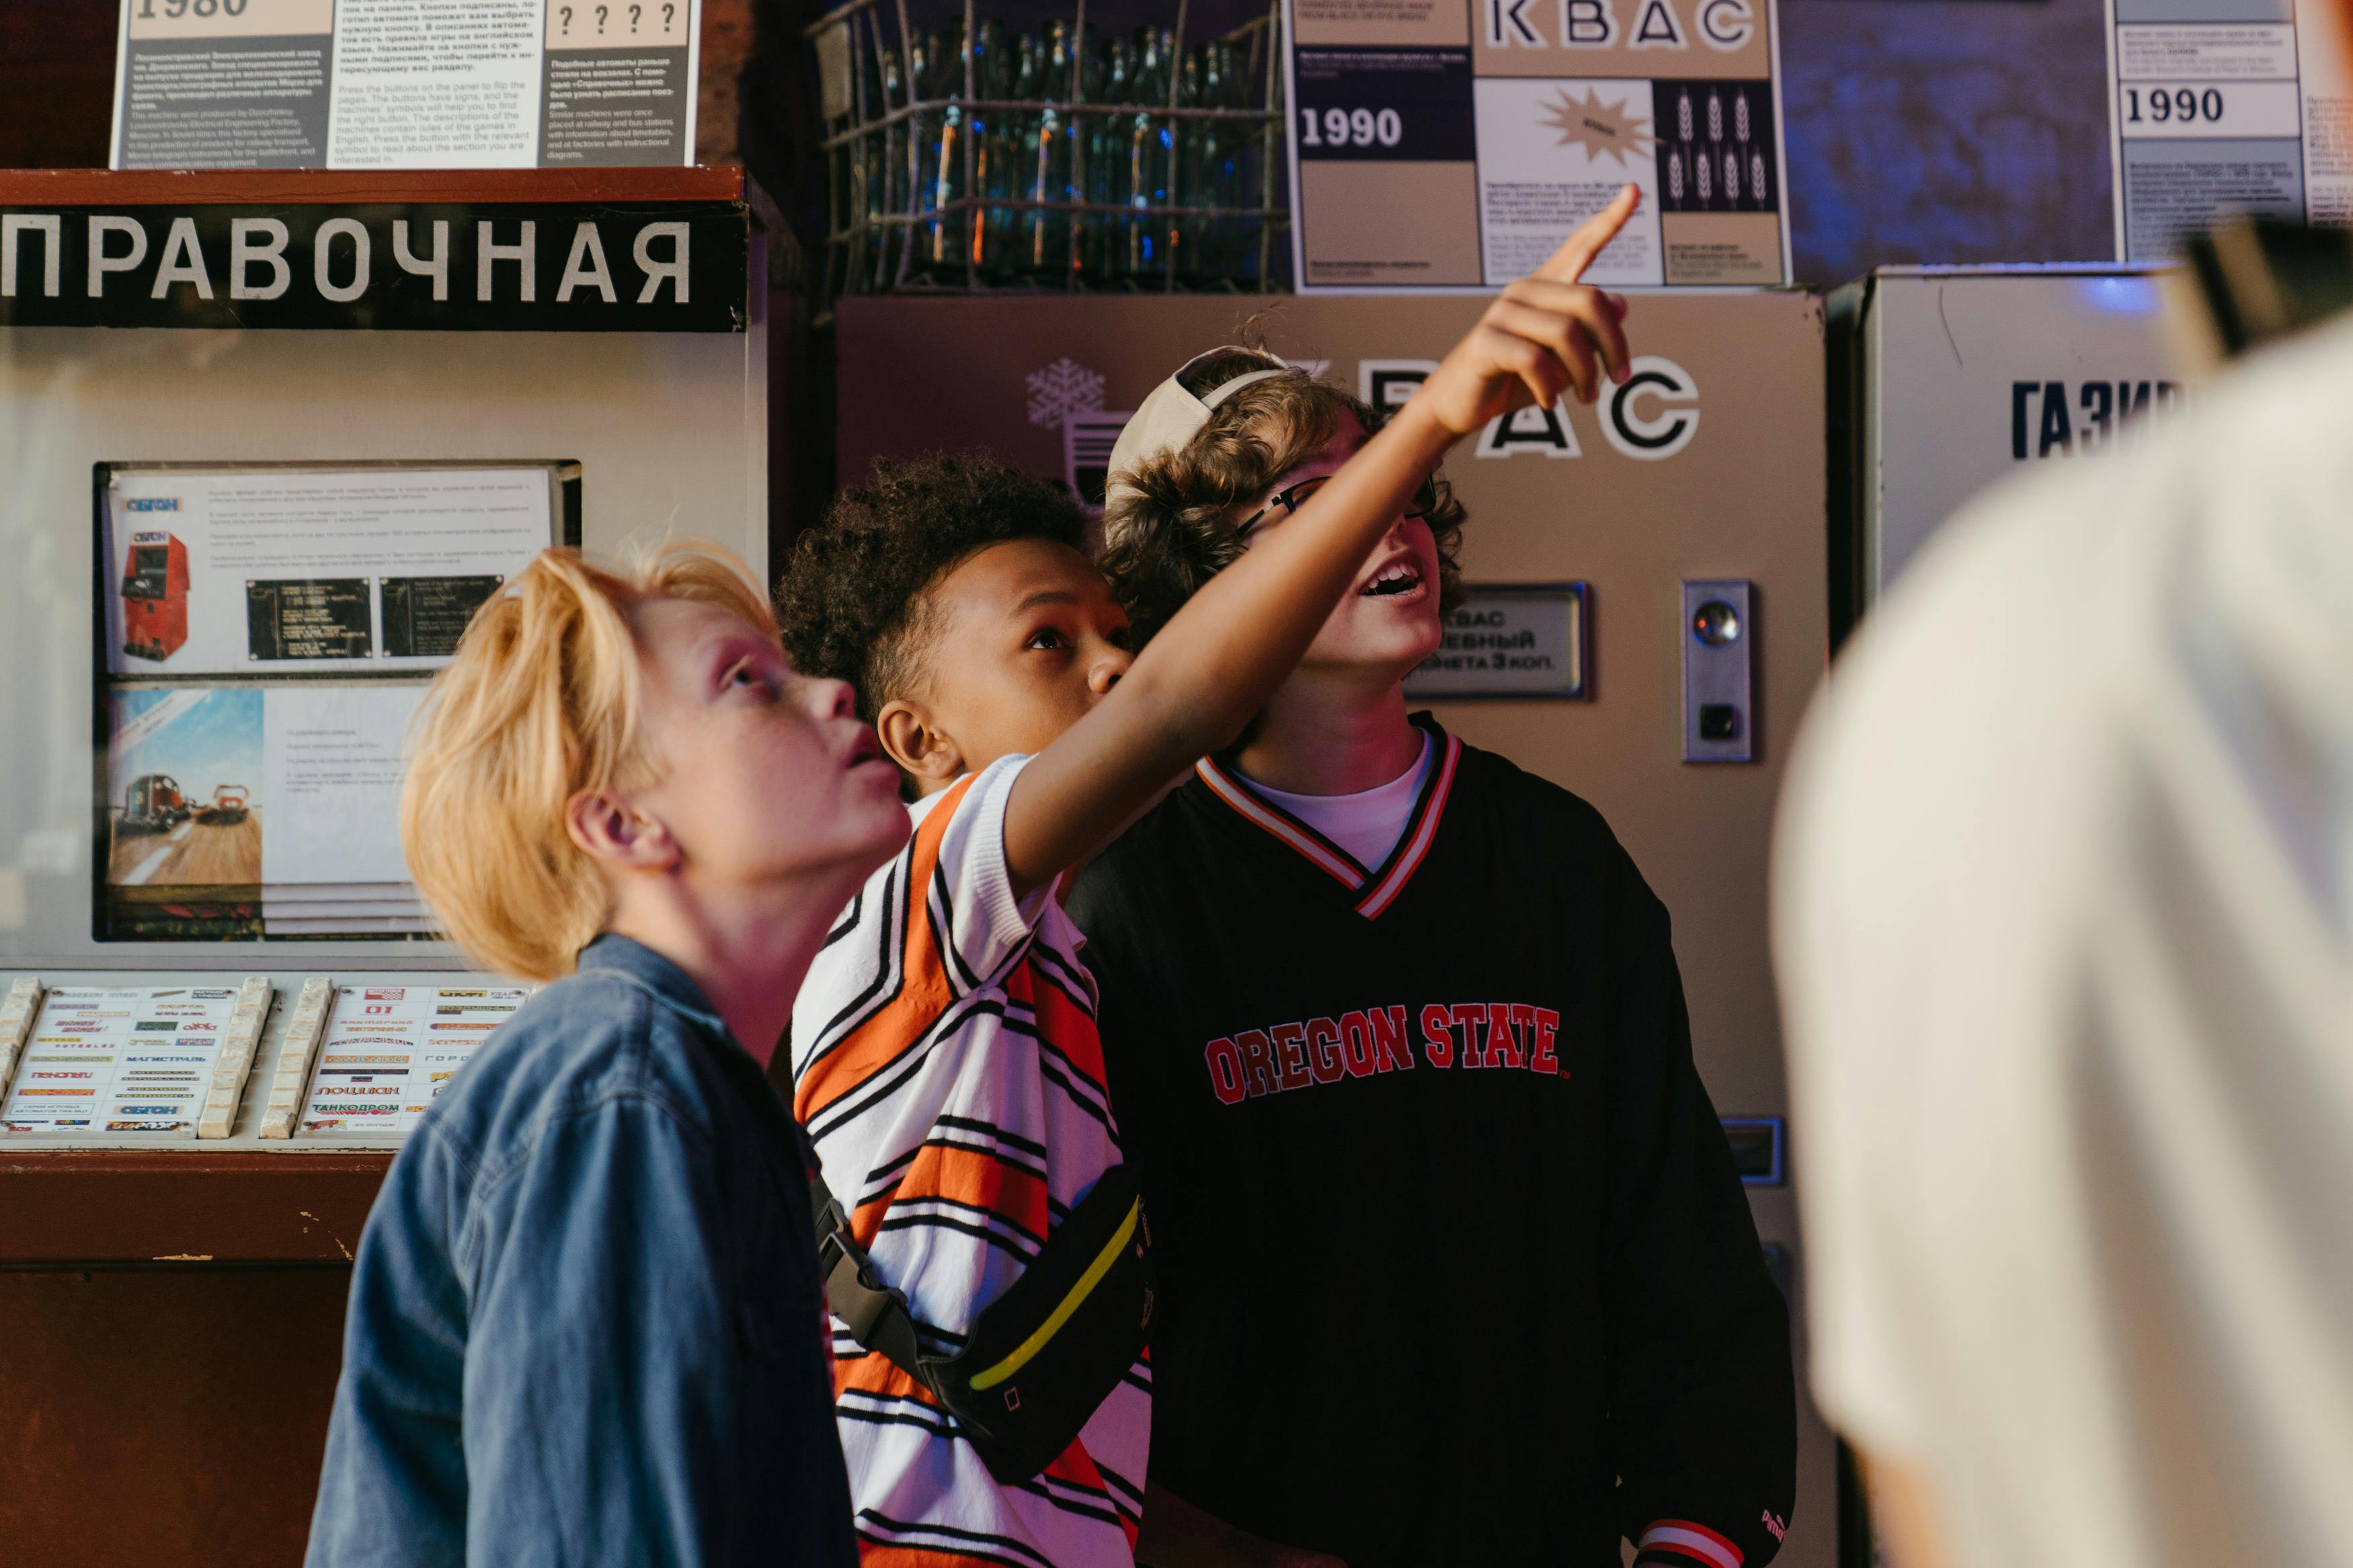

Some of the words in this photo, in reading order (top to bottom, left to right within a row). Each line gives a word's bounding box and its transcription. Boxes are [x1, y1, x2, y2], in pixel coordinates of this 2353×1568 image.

[420, 2, 456, 10] Кнопки
[491, 10, 534, 21] выбрать
[342, 26, 381, 34] нужную
[1485, 0, 1755, 52] КВАС
[385, 35, 427, 44] правила
[430, 34, 455, 42] игры
[473, 30, 533, 39] английском
[377, 43, 434, 52] Нажимайте
[433, 52, 463, 60] чтобы
[467, 52, 507, 62] перейти
[340, 66, 408, 75] тересующему
[338, 85, 363, 93] Press
[366, 84, 381, 92] the
[384, 83, 418, 91] buttons
[436, 83, 450, 91] the
[453, 82, 479, 92] panel
[493, 81, 508, 91] flip
[510, 81, 525, 89] the
[391, 93, 426, 101] buttons
[429, 93, 451, 101] have
[483, 91, 500, 99] and
[504, 91, 518, 99] the
[386, 104, 424, 114] symbols
[444, 103, 464, 113] help
[467, 104, 483, 112] you
[499, 101, 516, 110] find
[2126, 87, 2224, 122] 1990
[336, 115, 351, 123] the
[354, 114, 374, 124] right
[433, 112, 489, 123] descriptions
[492, 112, 501, 120] of
[504, 112, 518, 120] the
[336, 124, 379, 133] machines
[383, 124, 415, 132] contain
[420, 123, 441, 131] rules
[456, 122, 471, 130] the
[474, 124, 504, 132] games
[1301, 107, 1403, 148] 1990
[1, 214, 690, 304] ПРАВОЧНАЯ
[1443, 629, 1536, 649] ЕБНЫЙ
[1417, 655, 1488, 670] ОНЕТА
[1492, 653, 1507, 669] 3
[1204, 1003, 1416, 1106] OREGON
[1420, 1001, 1560, 1075] STATE
